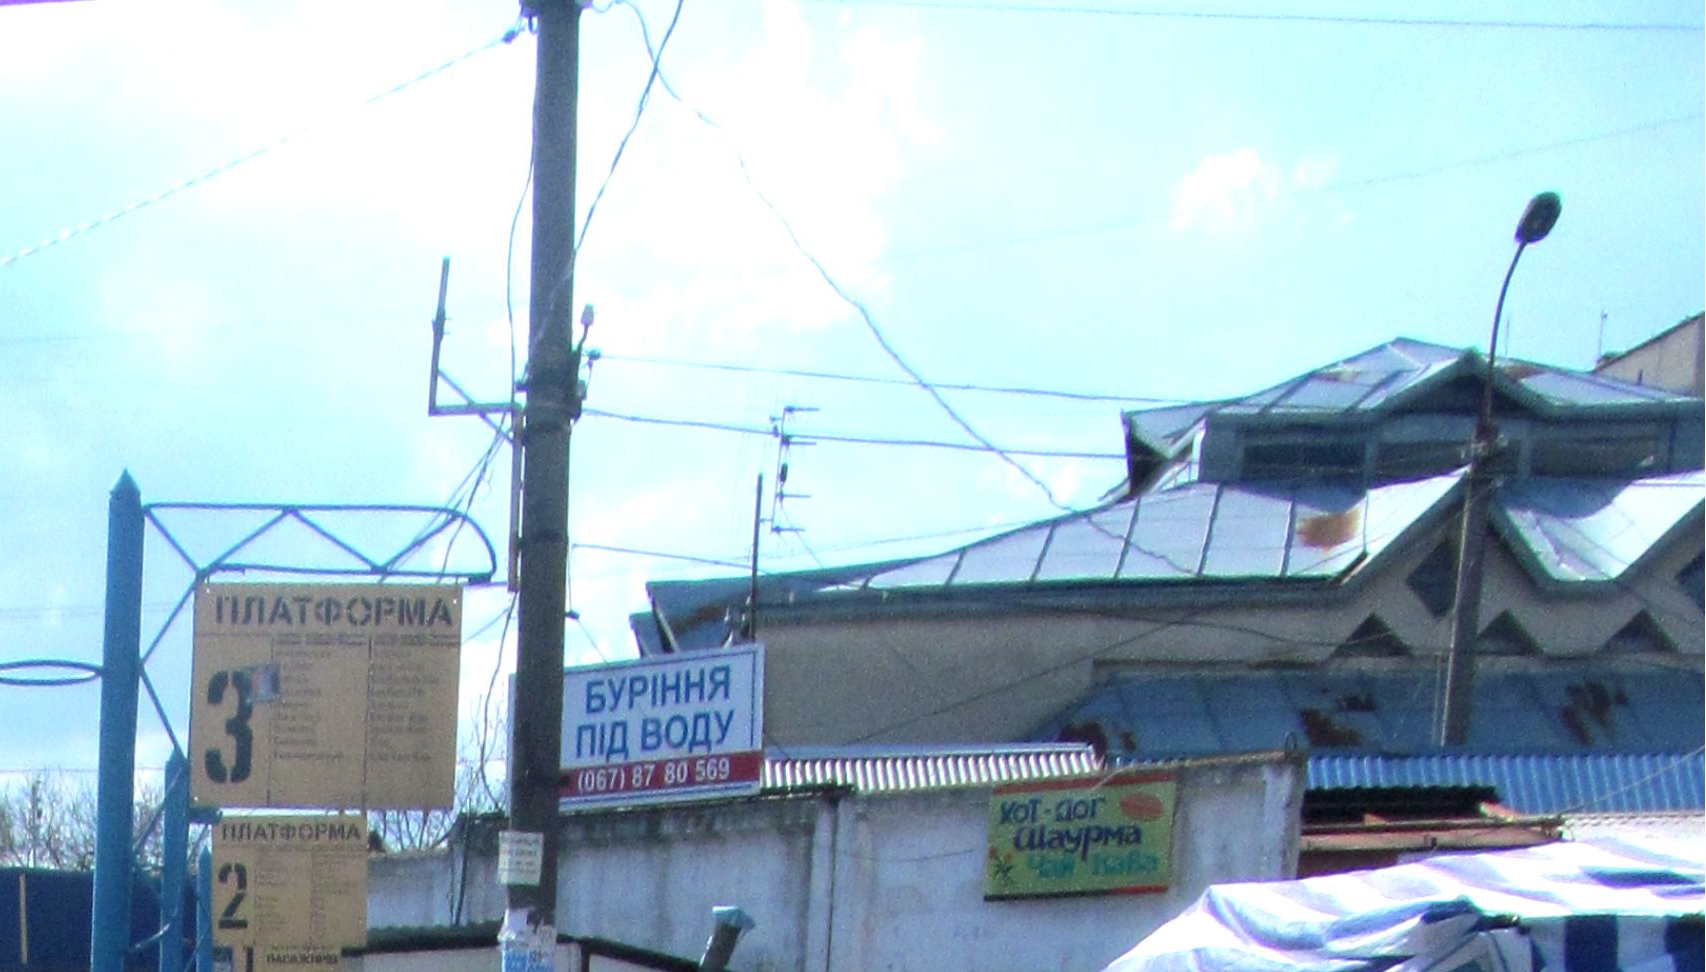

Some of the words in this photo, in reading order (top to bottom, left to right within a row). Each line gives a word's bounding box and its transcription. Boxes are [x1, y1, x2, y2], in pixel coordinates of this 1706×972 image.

[215, 593, 454, 628] ПЛАТФОРМА
[585, 663, 732, 715] БУРІННЯ
[204, 669, 255, 785] 3
[575, 719, 630, 764] ПІД
[640, 708, 736, 755] ВОДУ
[578, 768, 626, 795] (067)
[631, 765, 656, 788] 87
[663, 763, 688, 785] 80
[695, 757, 732, 782] 569
[220, 821, 363, 843] ПЛАТФОРМА
[217, 862, 249, 930] 2
